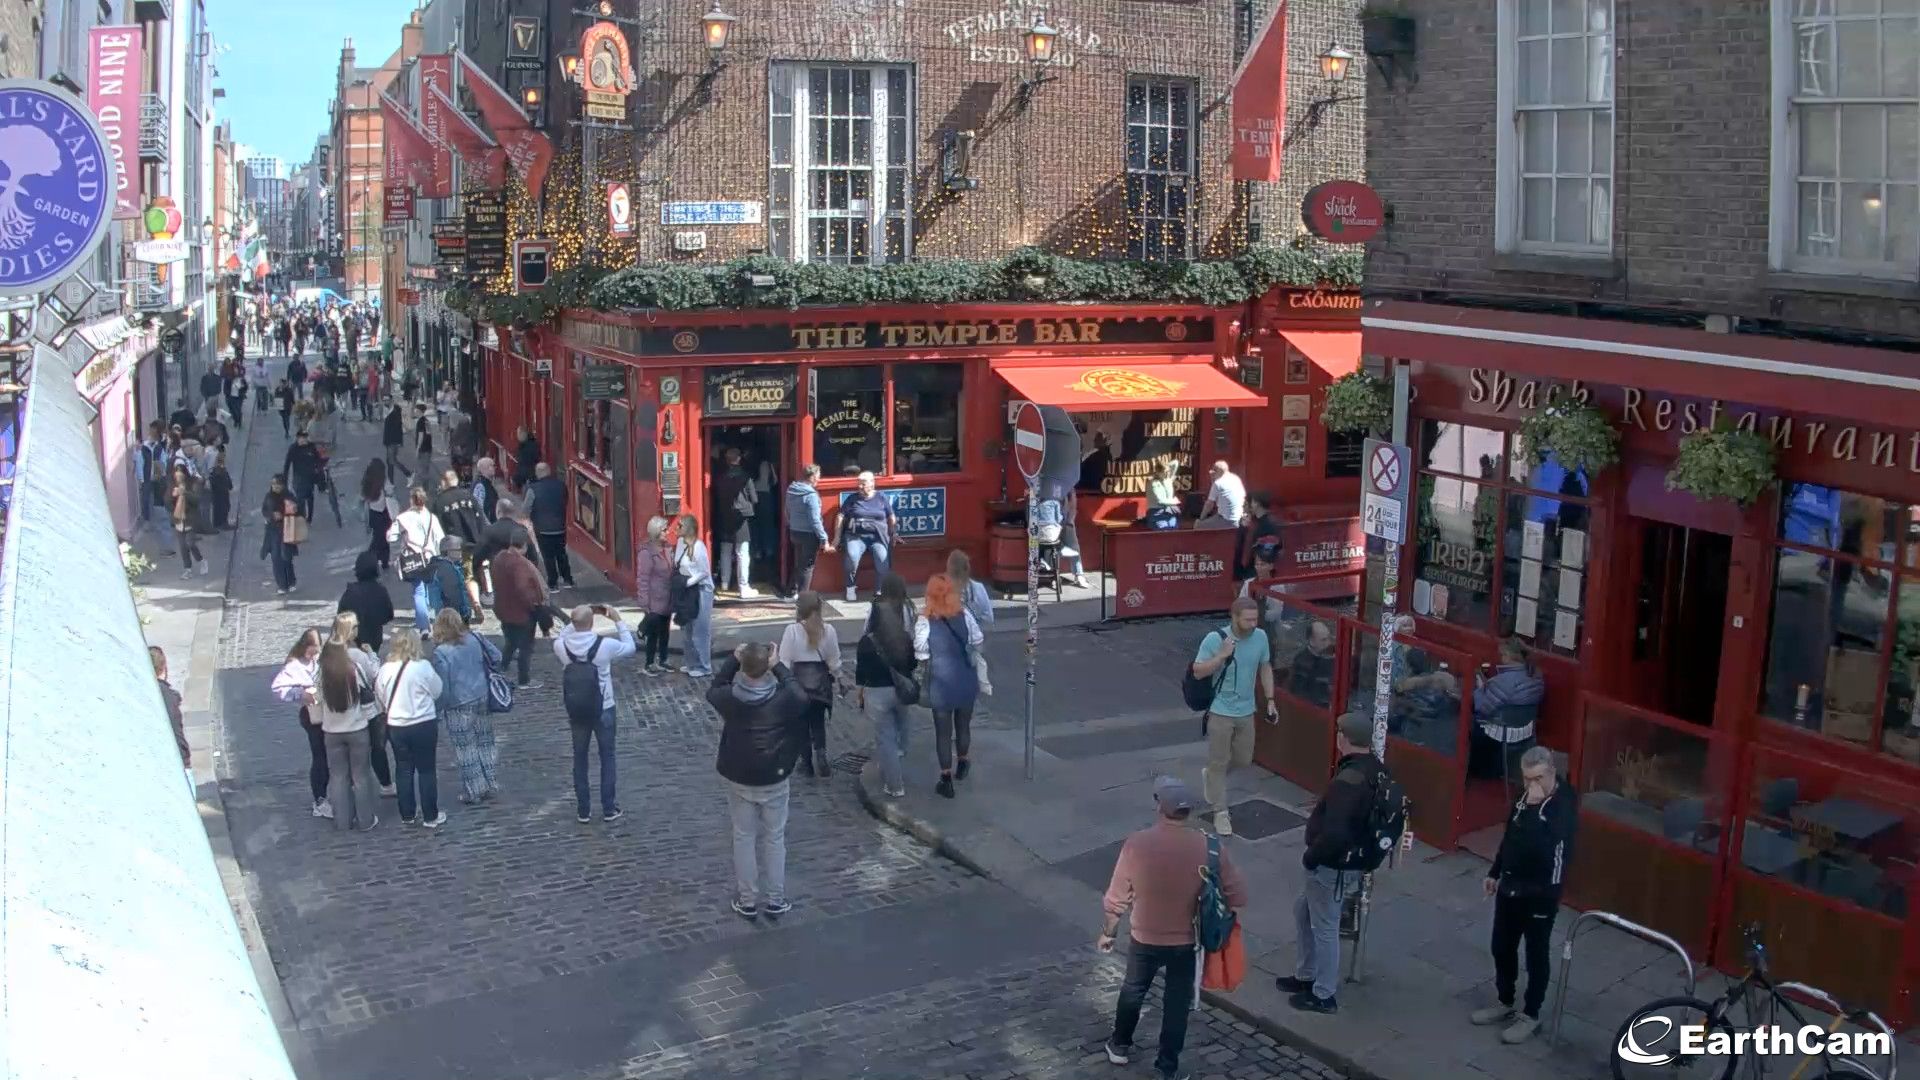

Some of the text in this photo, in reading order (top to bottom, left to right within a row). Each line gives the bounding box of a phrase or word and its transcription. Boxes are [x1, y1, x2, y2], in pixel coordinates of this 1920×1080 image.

[99, 33, 131, 96] NINE
[54, 112, 98, 202] YARD
[34, 198, 90, 228] GARDEN
[1325, 196, 1357, 216] Shack
[792, 322, 1101, 349] THE TEMPLE BAR
[723, 384, 785, 408] TOBACCO
[815, 411, 882, 432] TEMPLE BAR
[1172, 408, 1194, 422] THE
[1621, 386, 1920, 473] Restaurant
[1367, 504, 1383, 523] 24
[1175, 553, 1195, 562] THE
[1295, 546, 1364, 563] TEMPLE BAR
[1145, 560, 1224, 574] TEMPLE BAR
